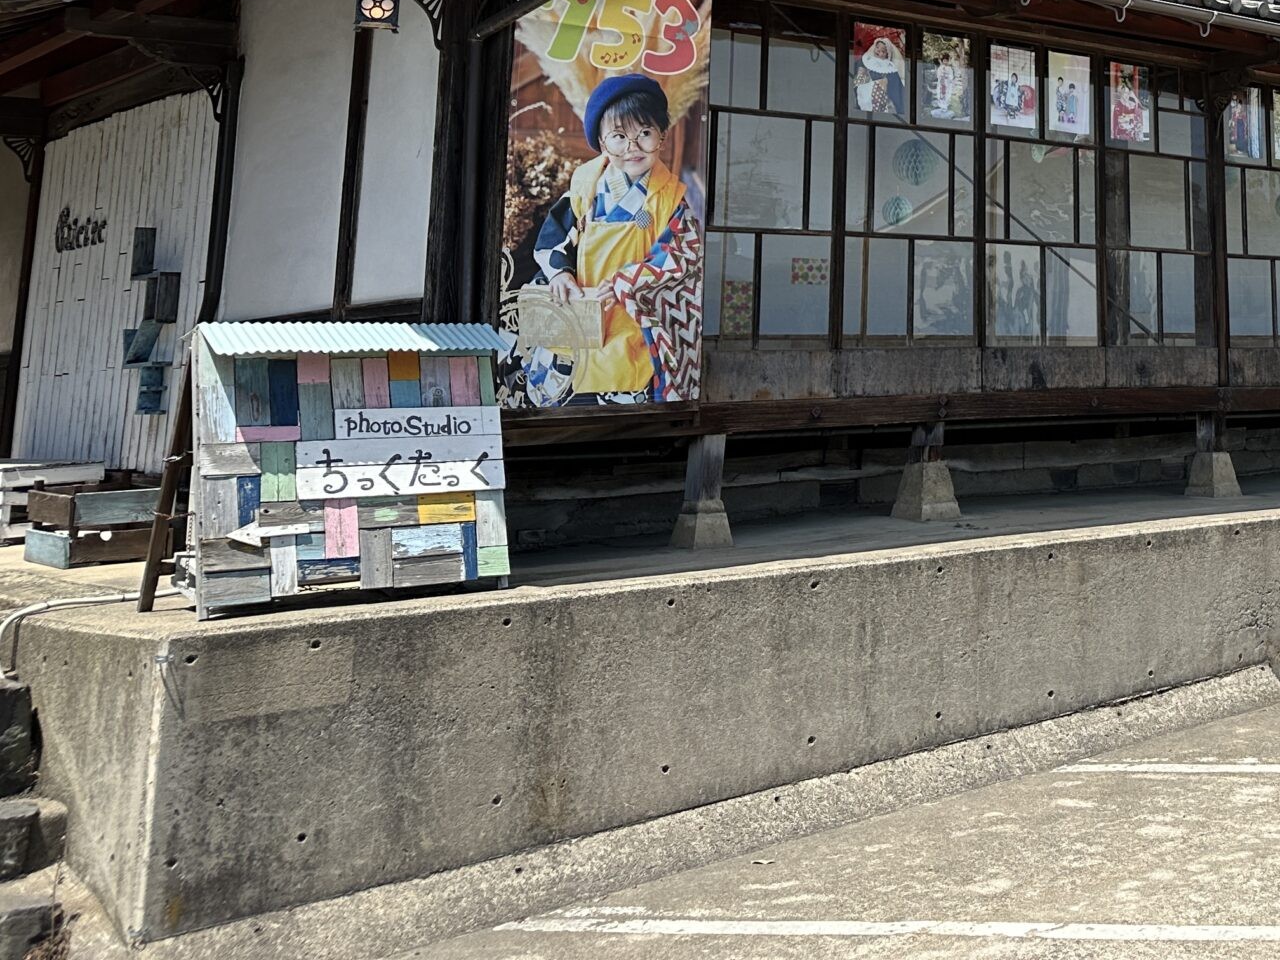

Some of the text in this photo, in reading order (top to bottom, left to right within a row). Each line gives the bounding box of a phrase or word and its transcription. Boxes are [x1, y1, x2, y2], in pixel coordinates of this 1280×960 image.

[315, 448, 490, 494] ちっくたっく
